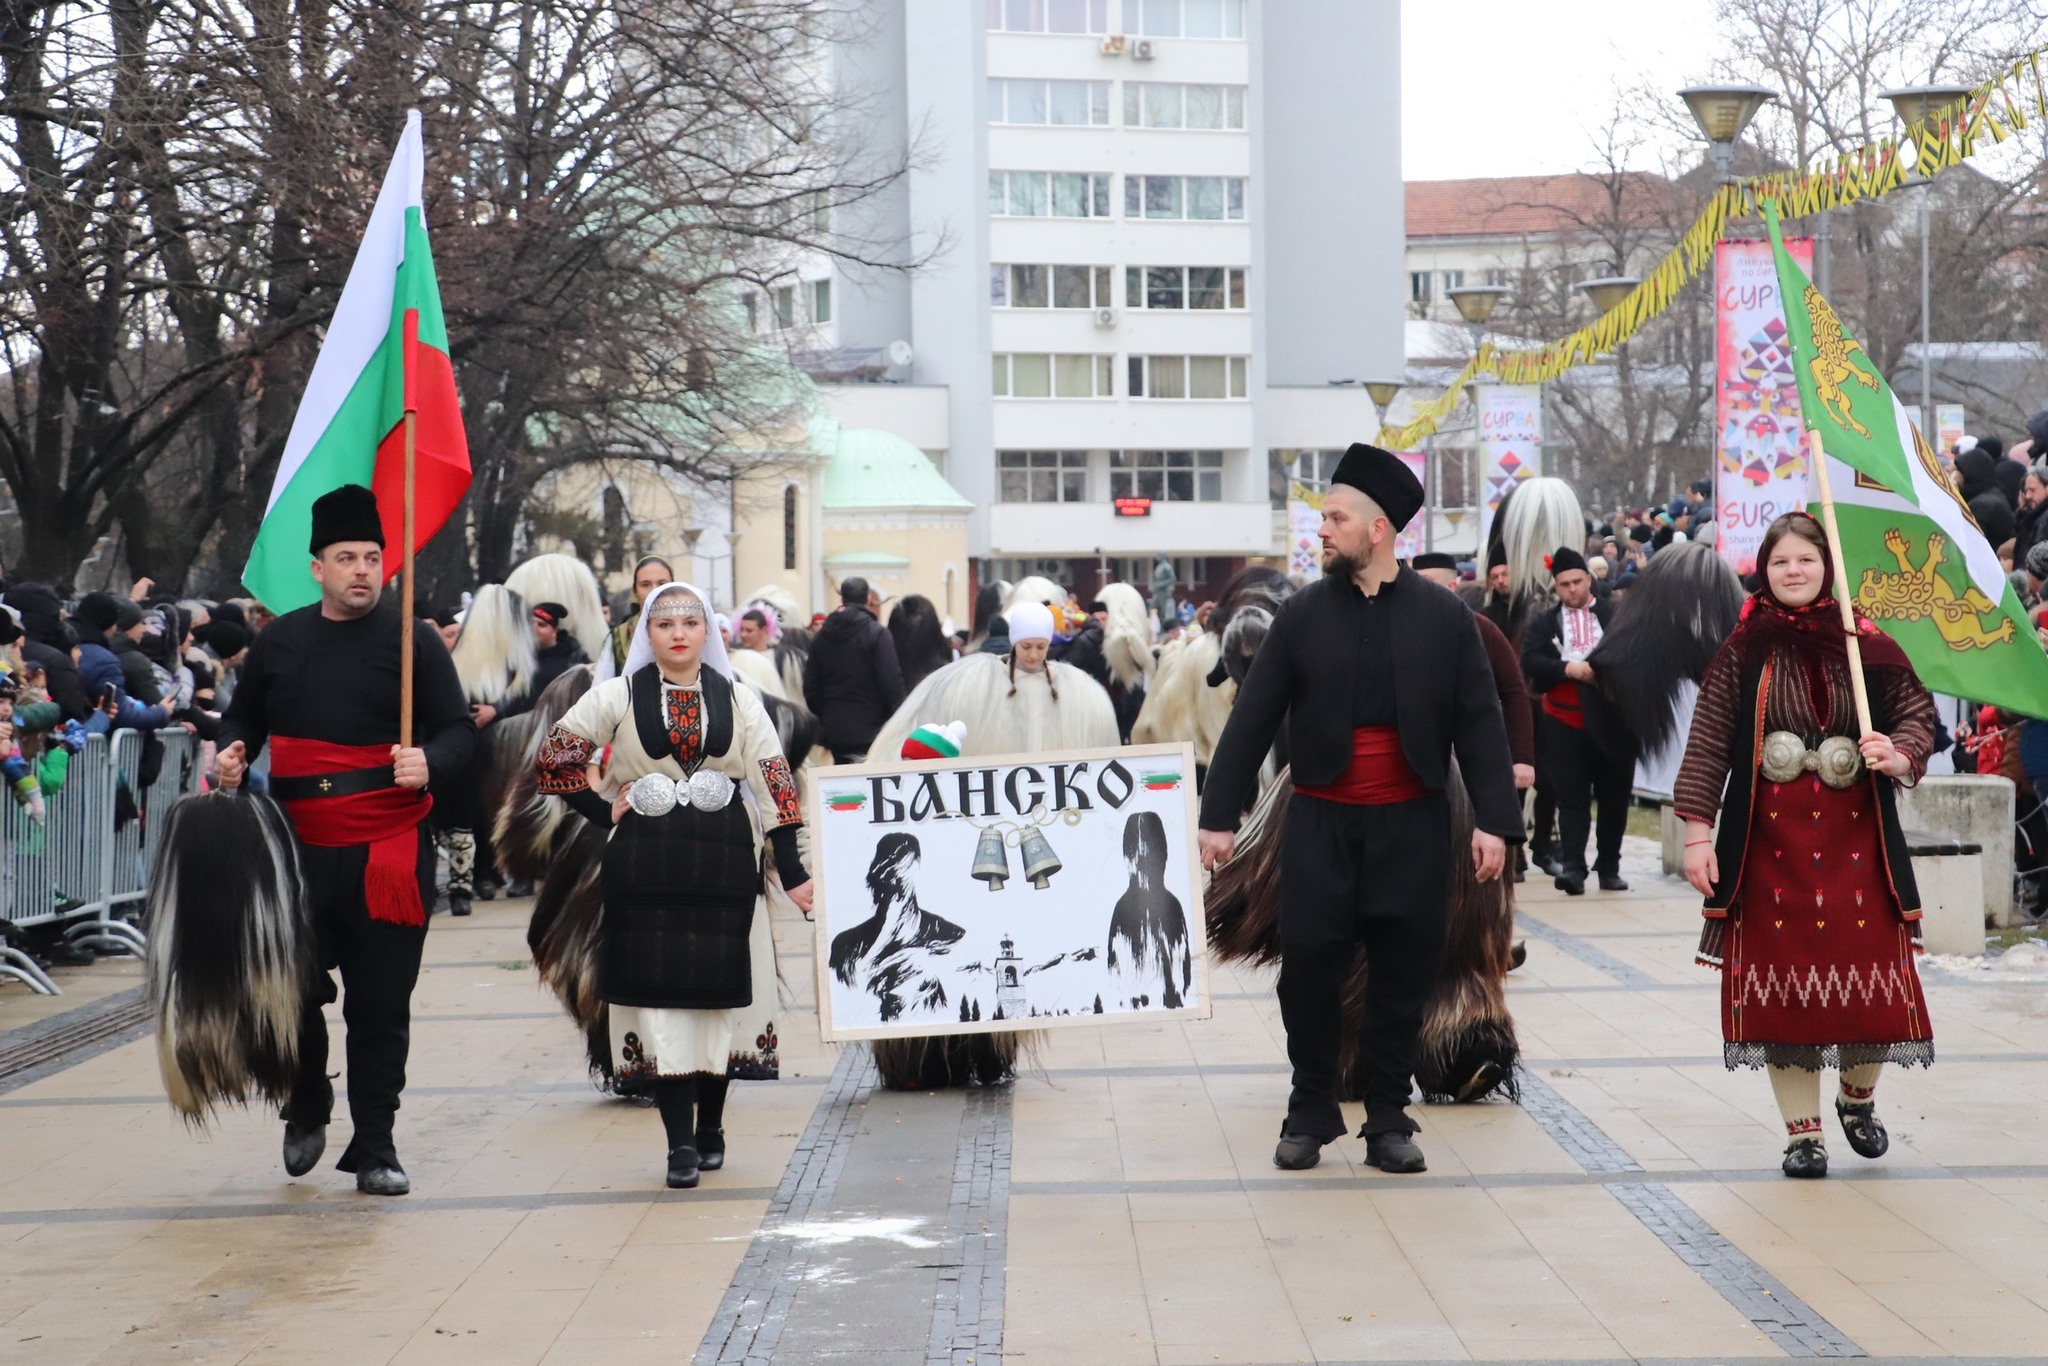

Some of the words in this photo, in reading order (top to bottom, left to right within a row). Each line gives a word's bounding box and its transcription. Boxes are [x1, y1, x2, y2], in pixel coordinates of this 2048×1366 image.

[1483, 410, 1535, 429] СУРВА
[1728, 535, 1754, 544] Share
[866, 759, 1134, 824] БАНСКО
